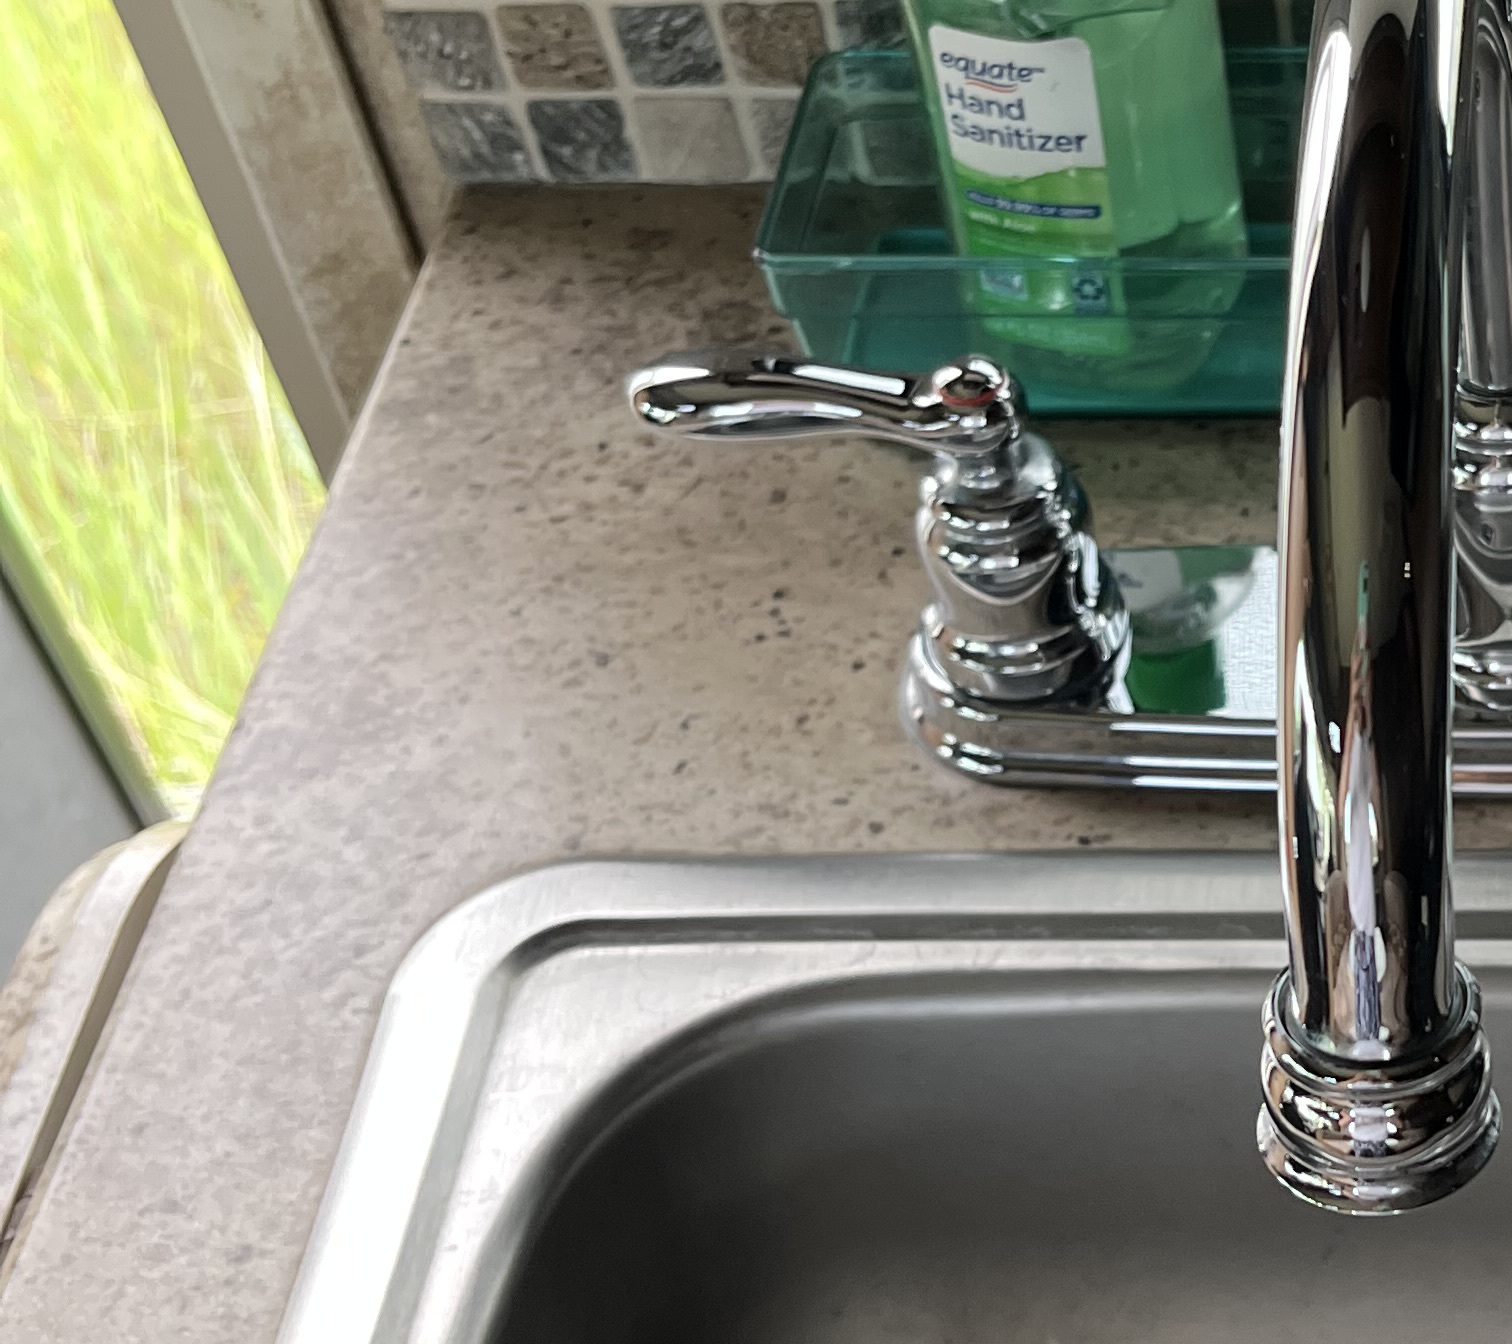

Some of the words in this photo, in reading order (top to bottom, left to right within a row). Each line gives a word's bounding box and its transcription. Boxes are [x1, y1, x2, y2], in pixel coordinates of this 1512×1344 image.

[940, 51, 1045, 83] equate
[944, 83, 1027, 122] Hand
[951, 113, 1088, 155] Sanitizer
